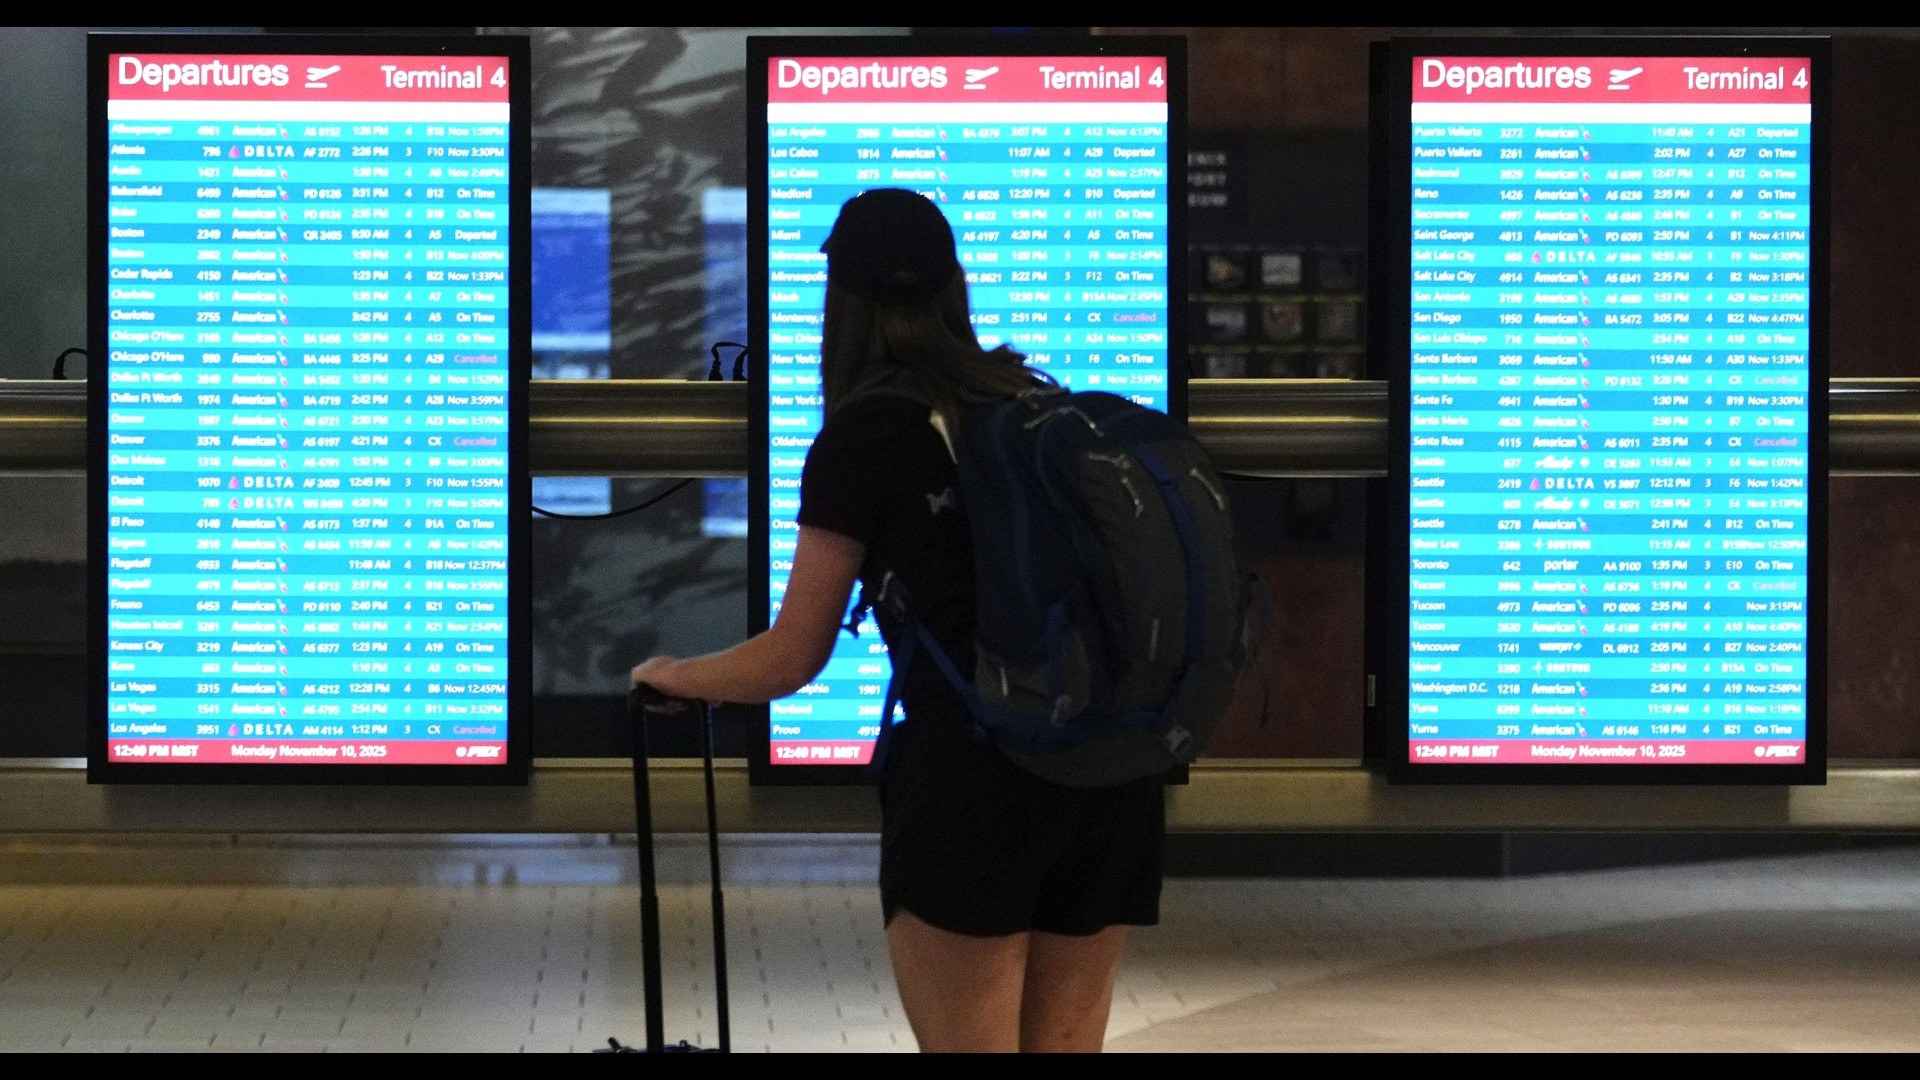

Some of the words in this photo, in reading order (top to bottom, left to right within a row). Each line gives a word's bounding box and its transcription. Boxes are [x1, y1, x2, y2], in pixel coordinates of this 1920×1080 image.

[119, 57, 289, 92] Departures
[380, 65, 482, 89] Terminal
[490, 66, 506, 88] 4
[778, 60, 948, 95] Departures
[1039, 65, 1140, 89] Terminal
[1148, 67, 1164, 88] 4
[1423, 59, 1592, 95] Departures
[1683, 66, 1784, 90] Terminal
[1792, 68, 1808, 89] 4
[110, 144, 146, 155] Atlanta
[244, 145, 294, 157] DELTA
[448, 147, 470, 157] Now
[471, 147, 505, 157] 3:30PM
[771, 147, 788, 158] Los
[788, 147, 819, 158] Cabos
[1113, 147, 1156, 159] Departed
[1414, 146, 1446, 157] Puerto
[1447, 147, 1482, 158] Vallarta
[1758, 148, 1773, 158] On
[1774, 148, 1797, 158] Time
[456, 188, 472, 199] On
[473, 188, 496, 199] Time
[770, 188, 812, 199] Medford
[1114, 188, 1156, 200] Departed
[1414, 188, 1439, 199] Reno
[1758, 189, 1773, 199] On
[1774, 189, 1797, 200] Time
[111, 227, 145, 238] Boston
[455, 229, 497, 241] Departed
[770, 229, 801, 241] Miami
[1115, 229, 1130, 240] On
[1131, 230, 1154, 240] Time
[1414, 229, 1438, 240] Saint
[1439, 229, 1474, 242] George
[1749, 231, 1771, 241] Now
[1771, 231, 1805, 240] 4:11PM
[110, 268, 140, 279] Cedar
[140, 268, 173, 281] Rapids
[447, 271, 469, 281] Now
[471, 271, 504, 281] 1:33PM
[1115, 271, 1130, 281] On
[1131, 271, 1154, 281] Time
[1414, 270, 1432, 281] Salt
[1433, 271, 1455, 281] Lake
[1456, 271, 1476, 283] City
[1748, 272, 1770, 282] Now
[110, 309, 155, 320] Charlotte
[456, 312, 471, 323] On
[472, 312, 495, 323] Time
[1113, 312, 1157, 323] Cancelled
[1413, 312, 1432, 322] San
[1433, 312, 1462, 325] Diego
[1748, 314, 1770, 323] Now
[1771, 313, 1805, 323] 4:47PM
[110, 351, 150, 364] Chicago
[454, 354, 498, 364] Cancelled
[771, 354, 794, 364] New
[795, 354, 817, 364] York
[1115, 354, 1130, 364] On
[1131, 353, 1154, 364] Time
[1413, 353, 1440, 364] Santa
[1441, 353, 1478, 364] Barbara
[1748, 355, 1769, 364] Now
[1772, 355, 1804, 364] 1:33PM
[111, 392, 140, 403] Dallas
[152, 393, 183, 403] Worth
[447, 395, 469, 405] Now
[1413, 395, 1440, 405] Santa
[1441, 394, 1453, 405] Fe
[1748, 396, 1769, 405] Now
[1771, 396, 1804, 405] 3:30PM
[453, 437, 497, 446] Cancelled
[1413, 436, 1440, 446] Santa
[1441, 436, 1464, 446] Rosa
[1754, 437, 1798, 447] Cancelled
[243, 476, 294, 488] DELTA
[447, 478, 469, 487] Now
[471, 478, 504, 488] 1:55PM
[1412, 477, 1445, 487] Seattle
[1545, 477, 1594, 489] DELTA
[1747, 478, 1769, 488] Now
[110, 516, 121, 527] El
[121, 516, 144, 527] Paso
[456, 519, 471, 529] On
[471, 519, 495, 529] Time
[1412, 518, 1445, 528] Seattle
[1755, 519, 1770, 529] On
[1771, 519, 1794, 529] Time
[444, 560, 466, 570] Now
[468, 560, 506, 570] 12:37PM
[1412, 559, 1449, 570] Toronto
[1544, 559, 1579, 572] porter
[1755, 560, 1770, 570] On
[1771, 560, 1794, 570] Time
[110, 599, 143, 609] Fresno
[455, 601, 471, 611] On
[472, 601, 494, 611] Time
[1411, 600, 1446, 611] Tucson
[1746, 602, 1768, 611] Now
[1769, 601, 1802, 611] 3:15PM
[110, 640, 144, 651] Kansas
[144, 640, 164, 653] City
[455, 642, 471, 652] On
[471, 642, 494, 653] Time
[1411, 641, 1461, 652] Vancouver
[1746, 643, 1767, 652] Now
[1769, 642, 1802, 652] 2:40PM
[110, 682, 127, 692] Las
[127, 682, 157, 694] Vegas
[444, 684, 465, 693] Now
[468, 684, 506, 693] 12:45PM
[1411, 682, 1468, 695] Washington
[1468, 682, 1488, 693] D.C.
[1746, 684, 1767, 693] Now
[111, 723, 128, 733] Los
[128, 723, 167, 735] Angeles
[243, 723, 293, 735] DELTA
[453, 725, 497, 735] Cancelled
[773, 725, 800, 735] Provo
[1411, 723, 1438, 734] Yuma
[1754, 724, 1769, 734] On
[1770, 724, 1792, 734] Time
[148, 745, 170, 757] PM
[231, 744, 278, 759] Monday
[279, 745, 338, 757] November
[340, 745, 357, 758] 10,
[359, 745, 387, 757] 2025
[810, 745, 832, 758] PM
[1449, 745, 1470, 757] PM
[1531, 745, 1577, 759] Monday
[1578, 745, 1637, 757] November
[1639, 745, 1656, 758] 10,
[1658, 745, 1686, 757] 2025
